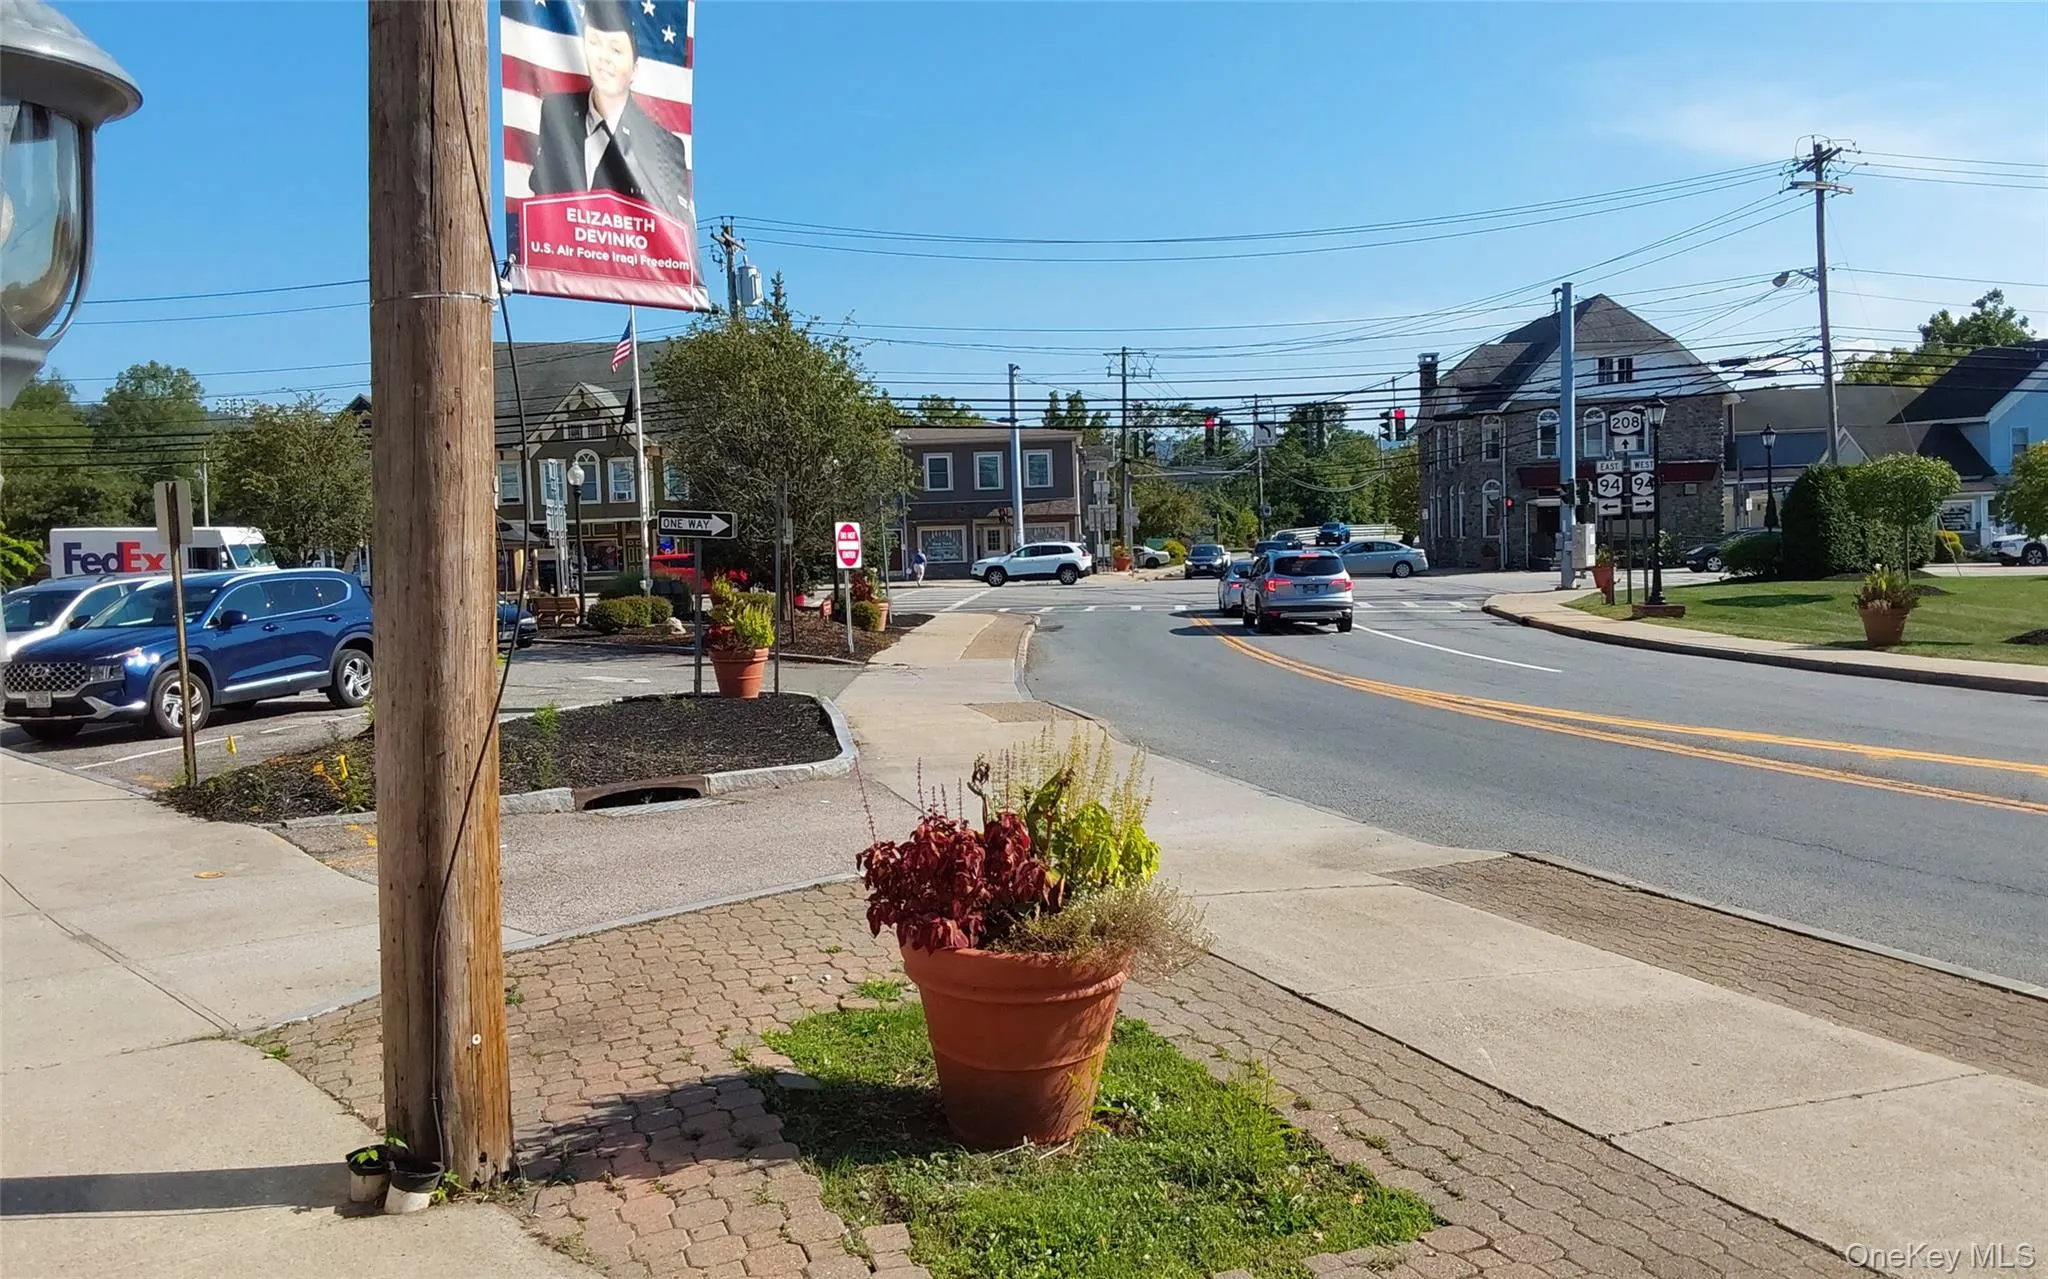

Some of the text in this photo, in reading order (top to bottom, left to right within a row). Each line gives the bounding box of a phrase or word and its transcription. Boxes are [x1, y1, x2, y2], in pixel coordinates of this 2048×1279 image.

[566, 208, 656, 233] ELIZABETH
[575, 228, 648, 250] DEVINKO
[531, 241, 690, 271] U.S. Air Force Iraqi Freedom
[1612, 417, 1640, 429] 208
[1600, 462, 1619, 471] EAST
[1634, 460, 1654, 469] WEST
[1600, 478, 1621, 492] 94
[1634, 476, 1655, 491] 94
[663, 518, 710, 529] ONE WAY
[63, 542, 167, 575] FedEx
